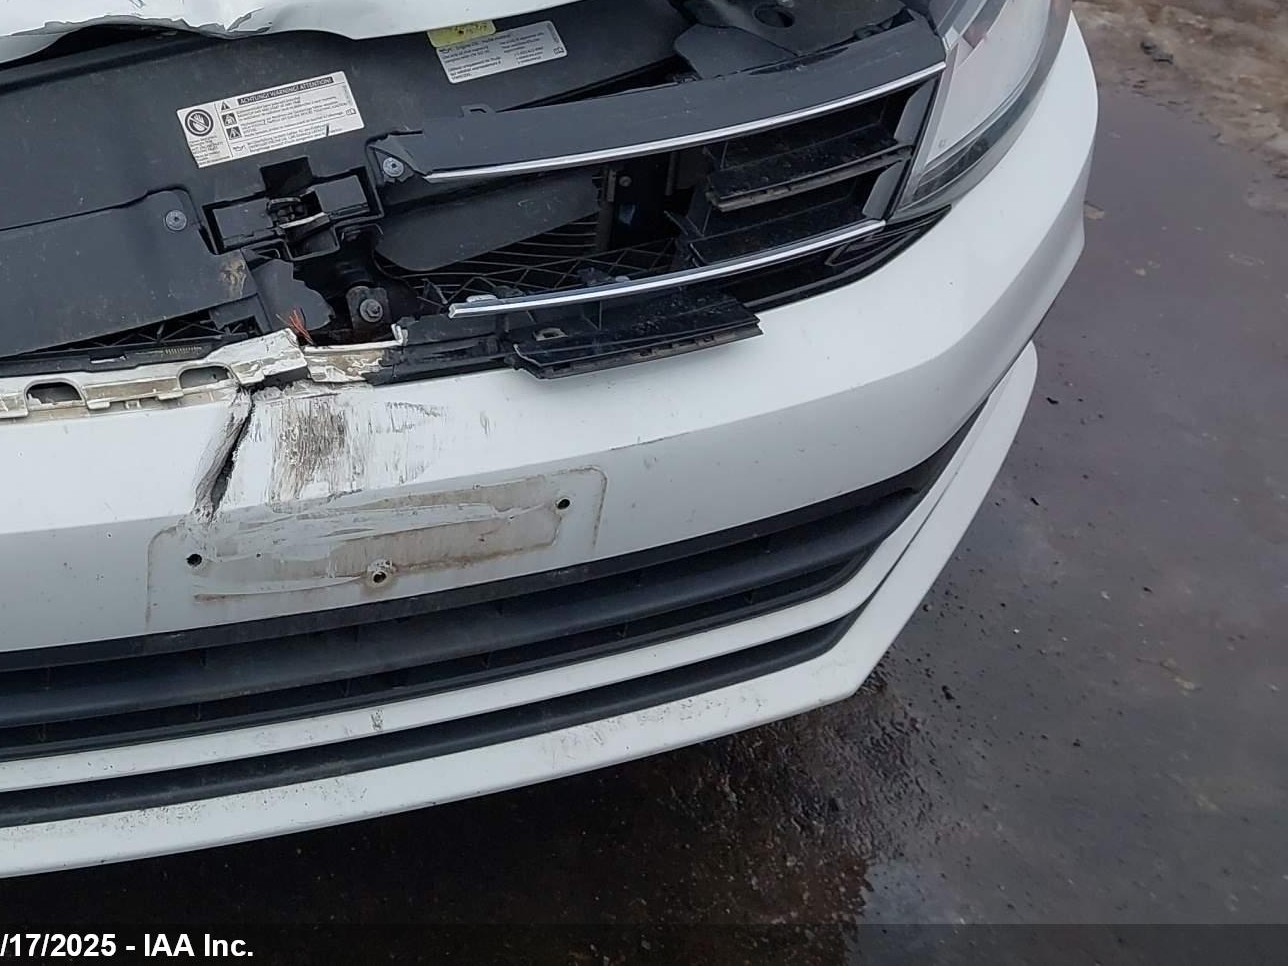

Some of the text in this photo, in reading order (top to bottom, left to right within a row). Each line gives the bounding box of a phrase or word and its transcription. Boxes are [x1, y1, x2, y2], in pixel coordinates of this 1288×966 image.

[240, 77, 333, 104] ACHTUNG! WARNING! ATTENTION!
